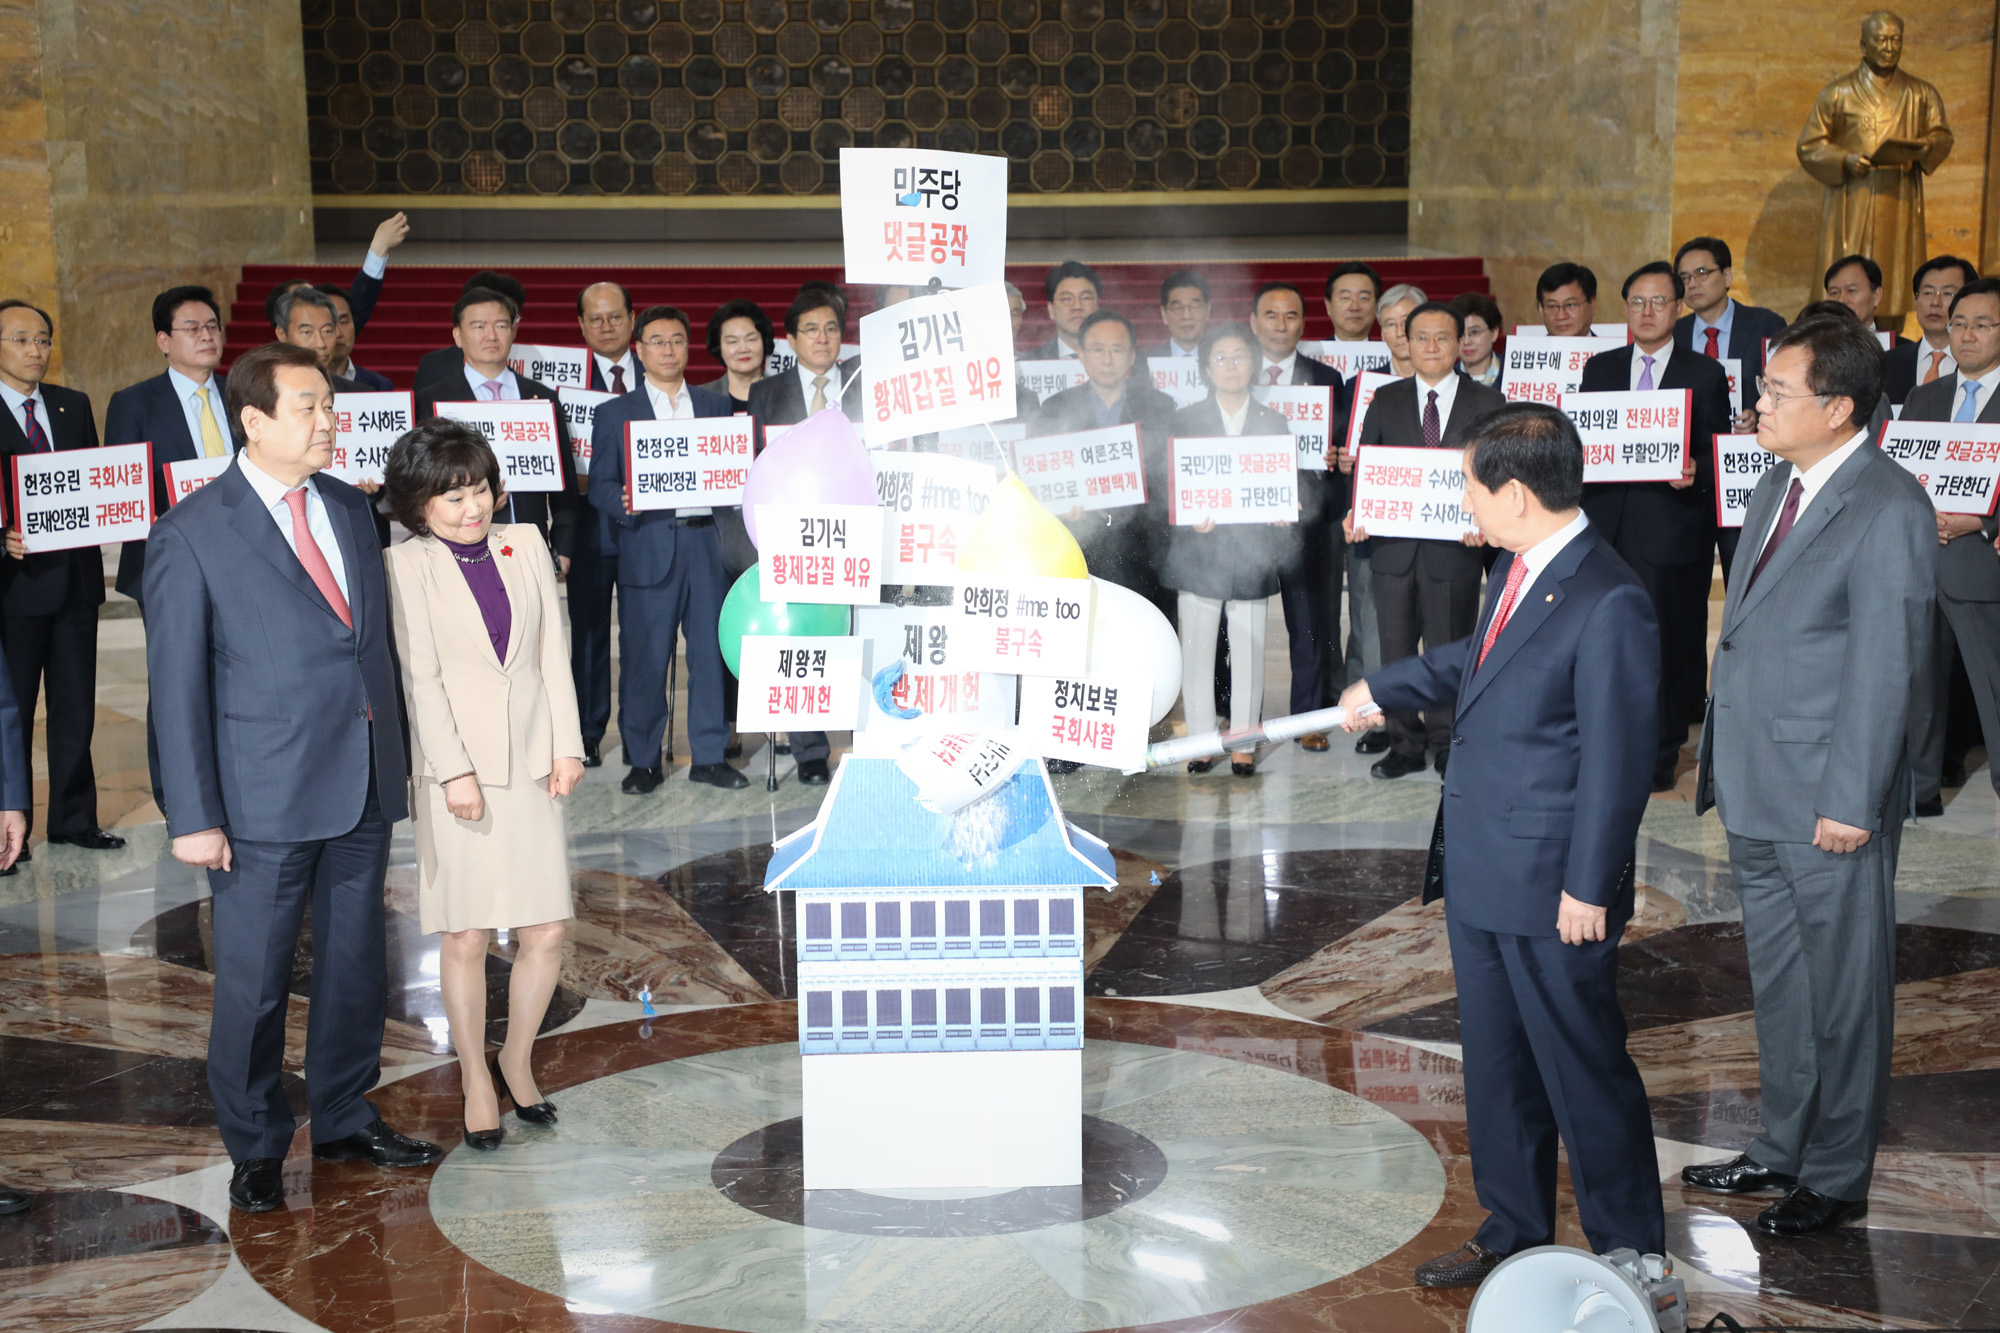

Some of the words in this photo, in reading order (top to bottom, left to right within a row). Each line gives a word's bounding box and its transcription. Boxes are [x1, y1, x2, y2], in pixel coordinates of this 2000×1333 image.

[894, 166, 961, 211] 민주당
[884, 221, 968, 267] 댓글공작
[898, 310, 965, 362] 김기식
[531, 360, 582, 383] 압박공작
[771, 354, 797, 373] 국회
[1511, 350, 1562, 370] 입법부에
[874, 365, 957, 422] 황제갑질
[966, 356, 1003, 402] 외유
[1507, 382, 1558, 402] 권력남용
[358, 410, 407, 433] 수사하듯
[1626, 406, 1680, 429] 전원사찰
[500, 420, 551, 442] 댓글공작
[636, 437, 690, 459] 헌정유린
[696, 434, 749, 456] 국회사찰
[1022, 449, 1075, 474] 댓글공작
[1080, 440, 1134, 465] 여론조작
[1621, 441, 1681, 464] 부활인가?
[1886, 438, 1941, 460] 국민기만
[1944, 440, 2000, 464] 댓글공작
[505, 455, 556, 476] 규탄한다
[1180, 454, 1233, 476] 국민기만
[1238, 452, 1292, 475] 댓글공작
[1364, 464, 1423, 488] 국정원댓글
[24, 470, 81, 497] 헌정유린
[89, 462, 144, 490] 국회사찰
[638, 471, 697, 493] 문재인정권
[1085, 471, 1139, 497] 일벌백계
[1934, 474, 1991, 498] 규탄한다
[1181, 488, 1233, 509] 민주당을
[1240, 486, 1293, 508] 규탄한다
[1361, 498, 1413, 522] 댓글공작
[26, 506, 90, 535] 문재인정권
[96, 499, 146, 527] 규탄한다
[800, 518, 847, 549] 김기식
[899, 523, 958, 565] 불구속
[772, 554, 835, 586] 황제갑질
[843, 556, 871, 588] 외유
[964, 586, 1010, 619] 안희정
[1055, 597, 1081, 620] too
[995, 626, 1044, 658] 불구속
[777, 649, 827, 678] 제왕적
[768, 685, 832, 715] 관제개헌
[1054, 679, 1118, 716] 정치보복
[1051, 714, 1116, 751] 국회사찰
